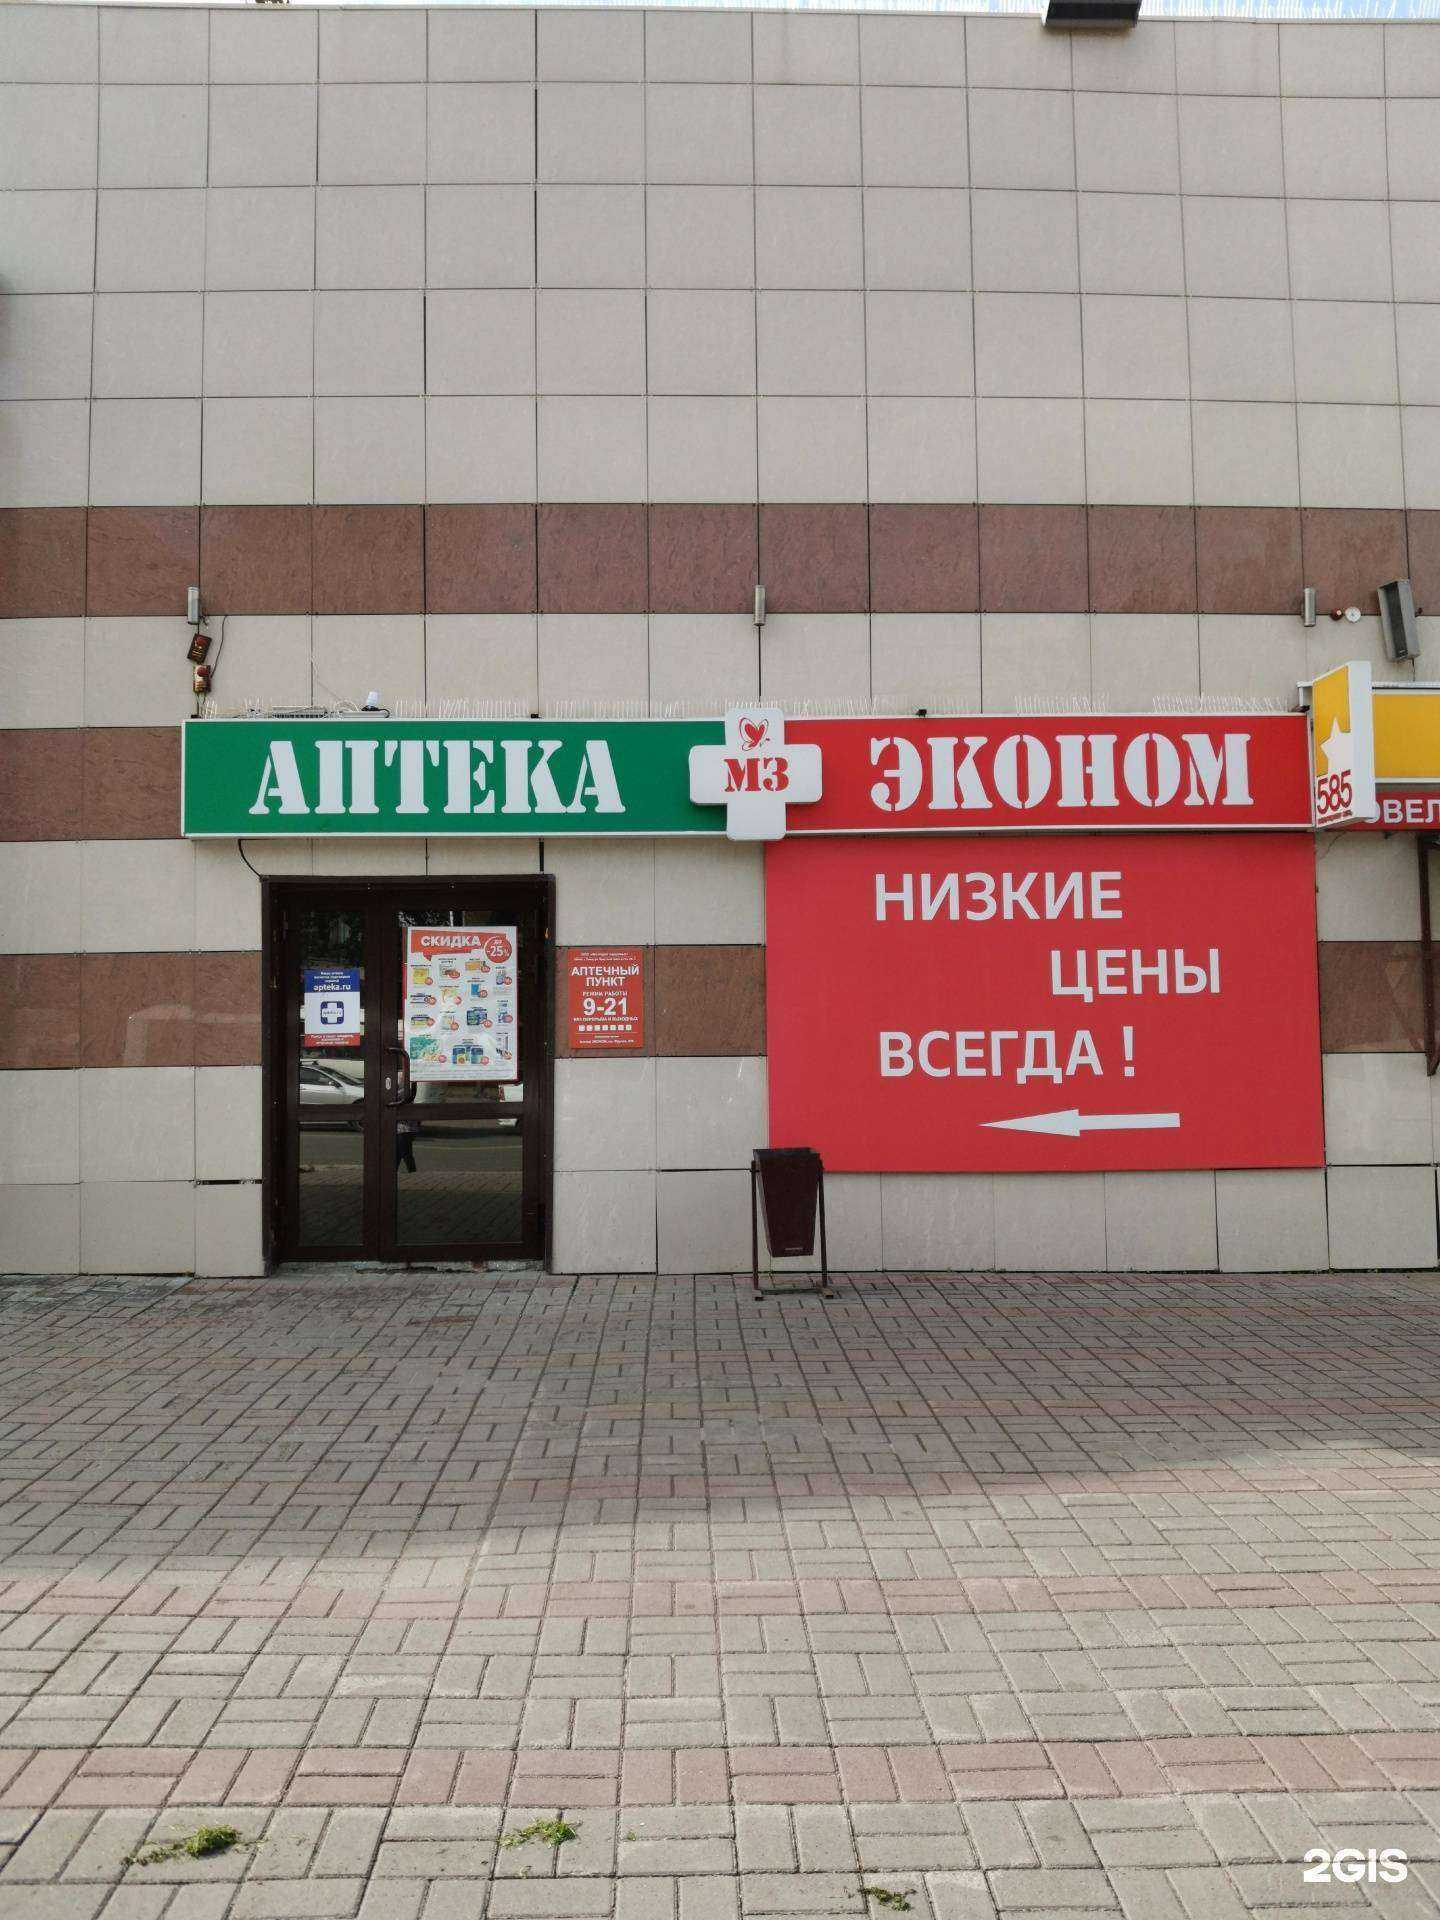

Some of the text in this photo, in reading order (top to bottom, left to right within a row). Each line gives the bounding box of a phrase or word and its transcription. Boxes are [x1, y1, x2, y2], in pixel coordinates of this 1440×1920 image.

[247, 739, 627, 815] АПТЕКА
[869, 732, 1255, 812] ЭКОНОМ
[1316, 768, 1353, 815] 585
[874, 870, 1123, 921] НИЗКИЕ
[420, 935, 482, 948] СКИДКА
[313, 983, 351, 992] apteka.ru
[571, 963, 640, 976] АПТЕЧНЫЙ
[586, 976, 626, 987] ПУНКТ
[1051, 948, 1221, 1003] ЦЕНЫ
[583, 997, 627, 1016] 9-21
[879, 1026, 1136, 1085] ВСЕГДА !
